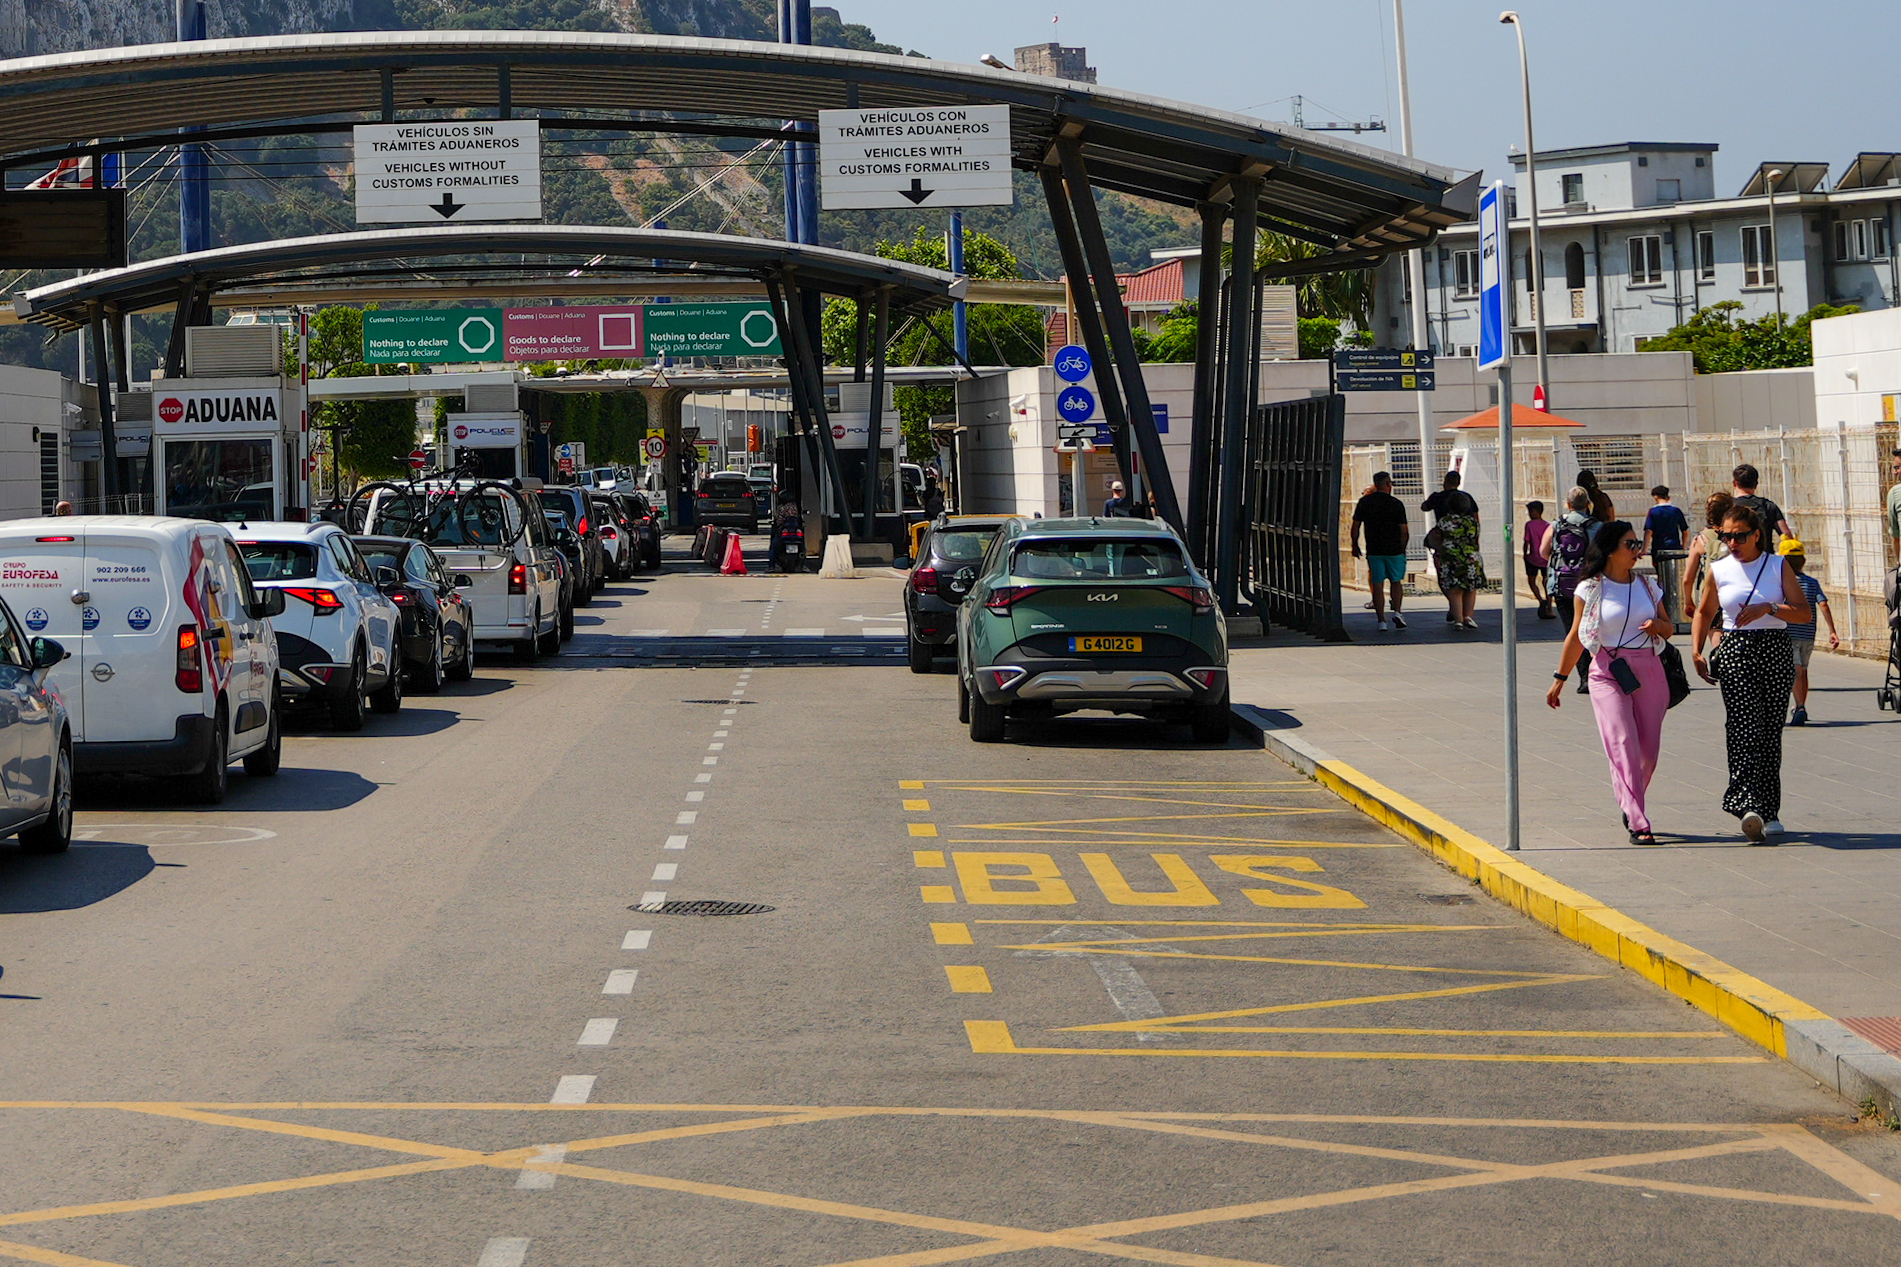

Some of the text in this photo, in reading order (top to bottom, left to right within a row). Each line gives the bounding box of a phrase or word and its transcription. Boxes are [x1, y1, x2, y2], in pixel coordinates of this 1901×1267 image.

[860, 111, 967, 124] VEHÍCULOS CON
[397, 126, 494, 138] VEHÍCULOS SIN
[838, 123, 990, 137] TRÁMITES ADUANEROS
[372, 138, 520, 151] TRÁMITES ADUANEROS
[864, 146, 962, 158] VEHICLES WITH
[385, 160, 506, 173] VEHICLES WITHOUT
[839, 161, 990, 175] CUSTOMS FORMALITIES
[372, 175, 519, 189] CUSTOMS FORMALITIES
[369, 338, 449, 349] Nothing to declare
[509, 335, 581, 345] Goods to declare
[650, 332, 730, 343] Nothing to declare
[369, 348, 441, 358] Nada para declarar
[509, 345, 590, 355] Objetos para declarar
[650, 342, 723, 352] Nada para declarar
[160, 396, 278, 423] STOP ADUANA
[649, 441, 662, 452] 10
[2, 570, 59, 580] EUROFESA
[951, 850, 1367, 909] BUS
